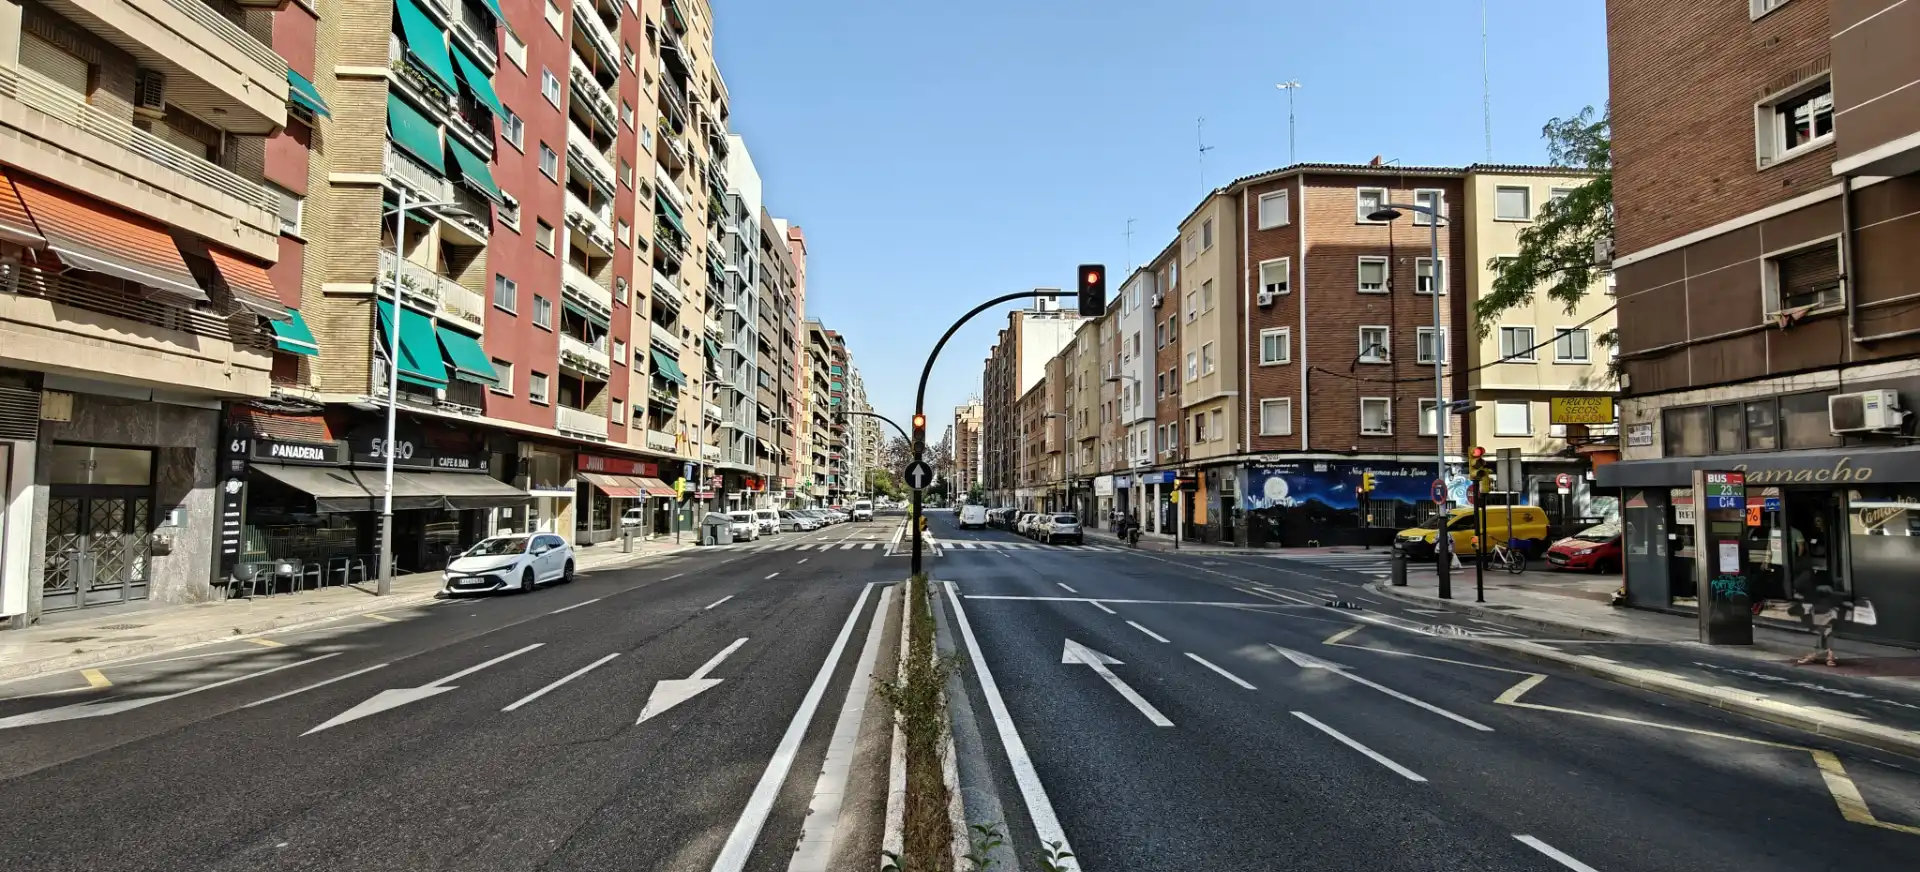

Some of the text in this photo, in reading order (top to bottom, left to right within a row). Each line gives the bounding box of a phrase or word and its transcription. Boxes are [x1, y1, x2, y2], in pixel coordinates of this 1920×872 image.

[1560, 398, 1602, 406] FRUTOS
[1565, 406, 1599, 414] SECOS
[231, 440, 246, 453] 61
[271, 444, 324, 460] PANADERIA
[370, 438, 414, 459] SOHO
[439, 457, 454, 467] CAFE
[458, 459, 469, 468] BAR
[480, 460, 487, 469] 61
[1707, 474, 1728, 483] BUS
[1720, 485, 1733, 496] 23
[1719, 496, 1736, 508] Ci4
